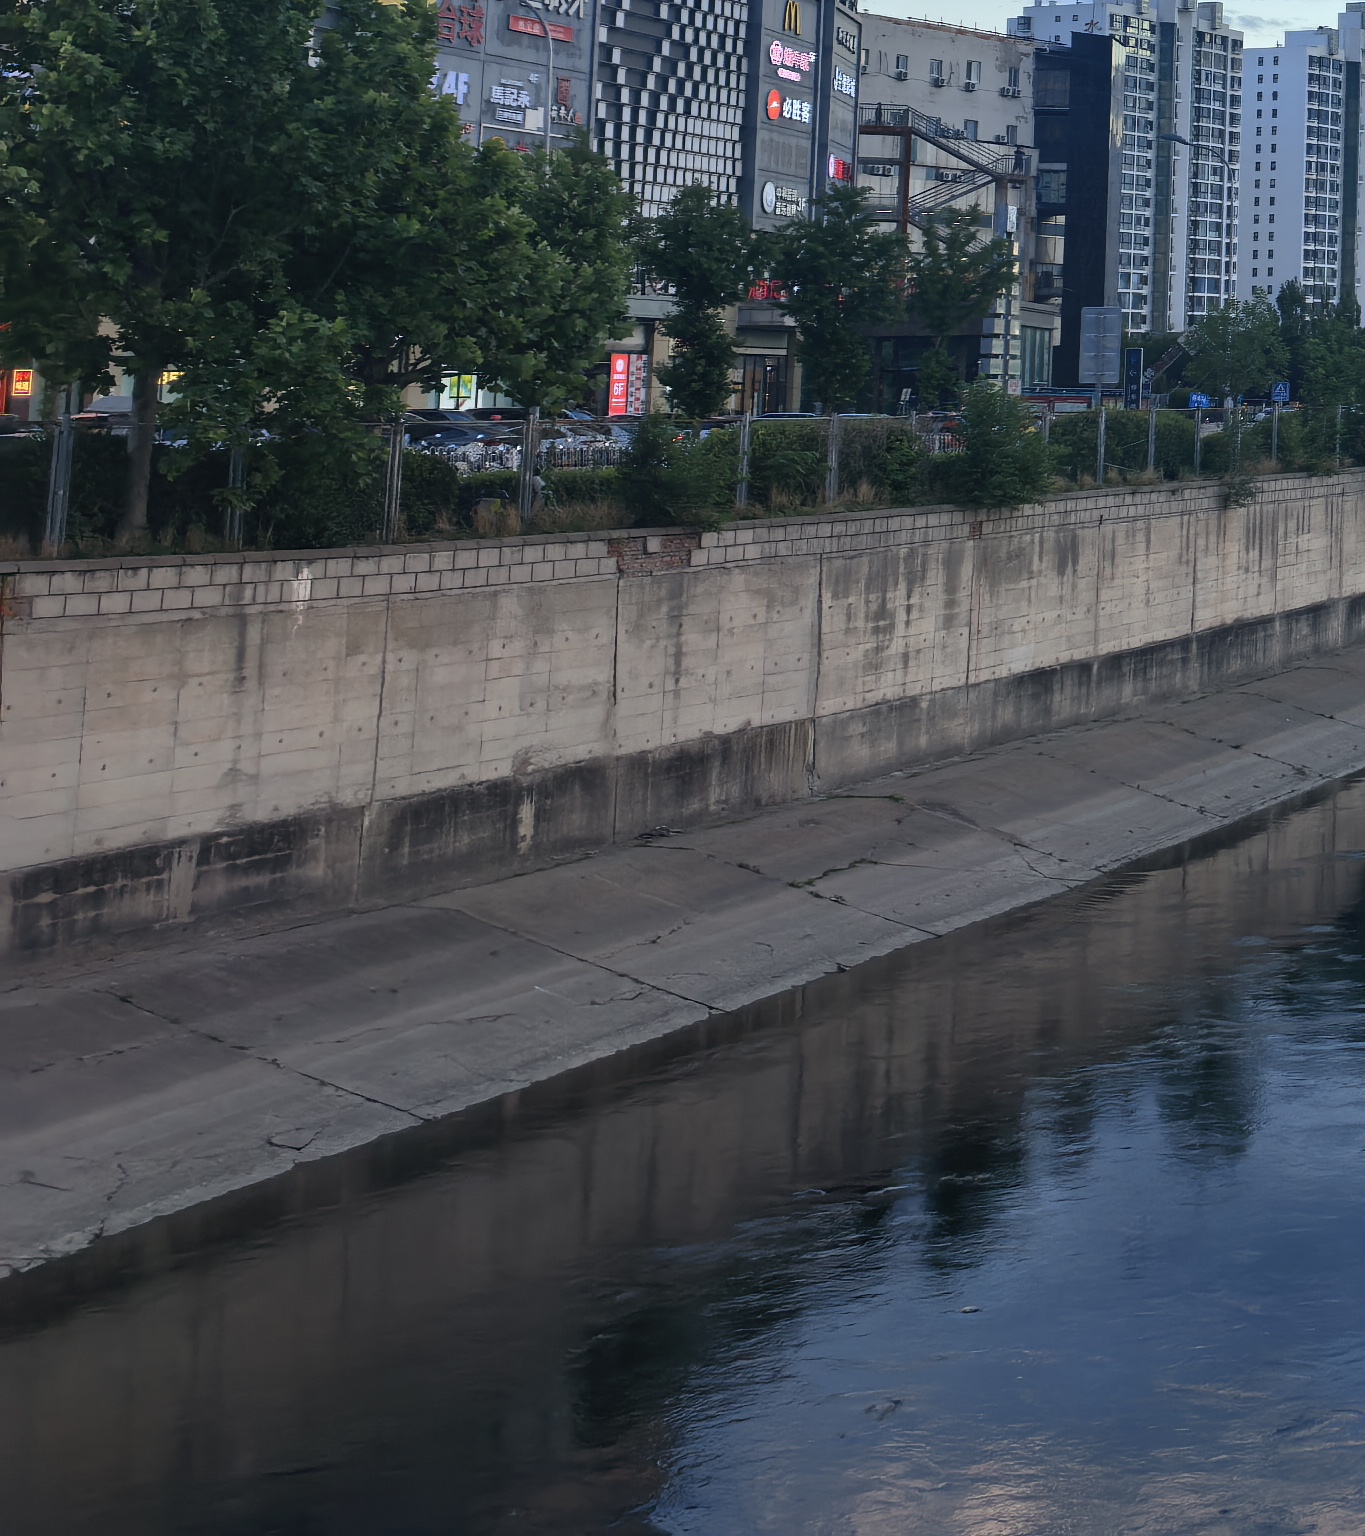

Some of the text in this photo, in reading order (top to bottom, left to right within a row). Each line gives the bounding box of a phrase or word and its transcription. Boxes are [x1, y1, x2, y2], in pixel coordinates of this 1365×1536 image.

[783, 97, 811, 123] 必胜客
[613, 382, 625, 395] 6F
